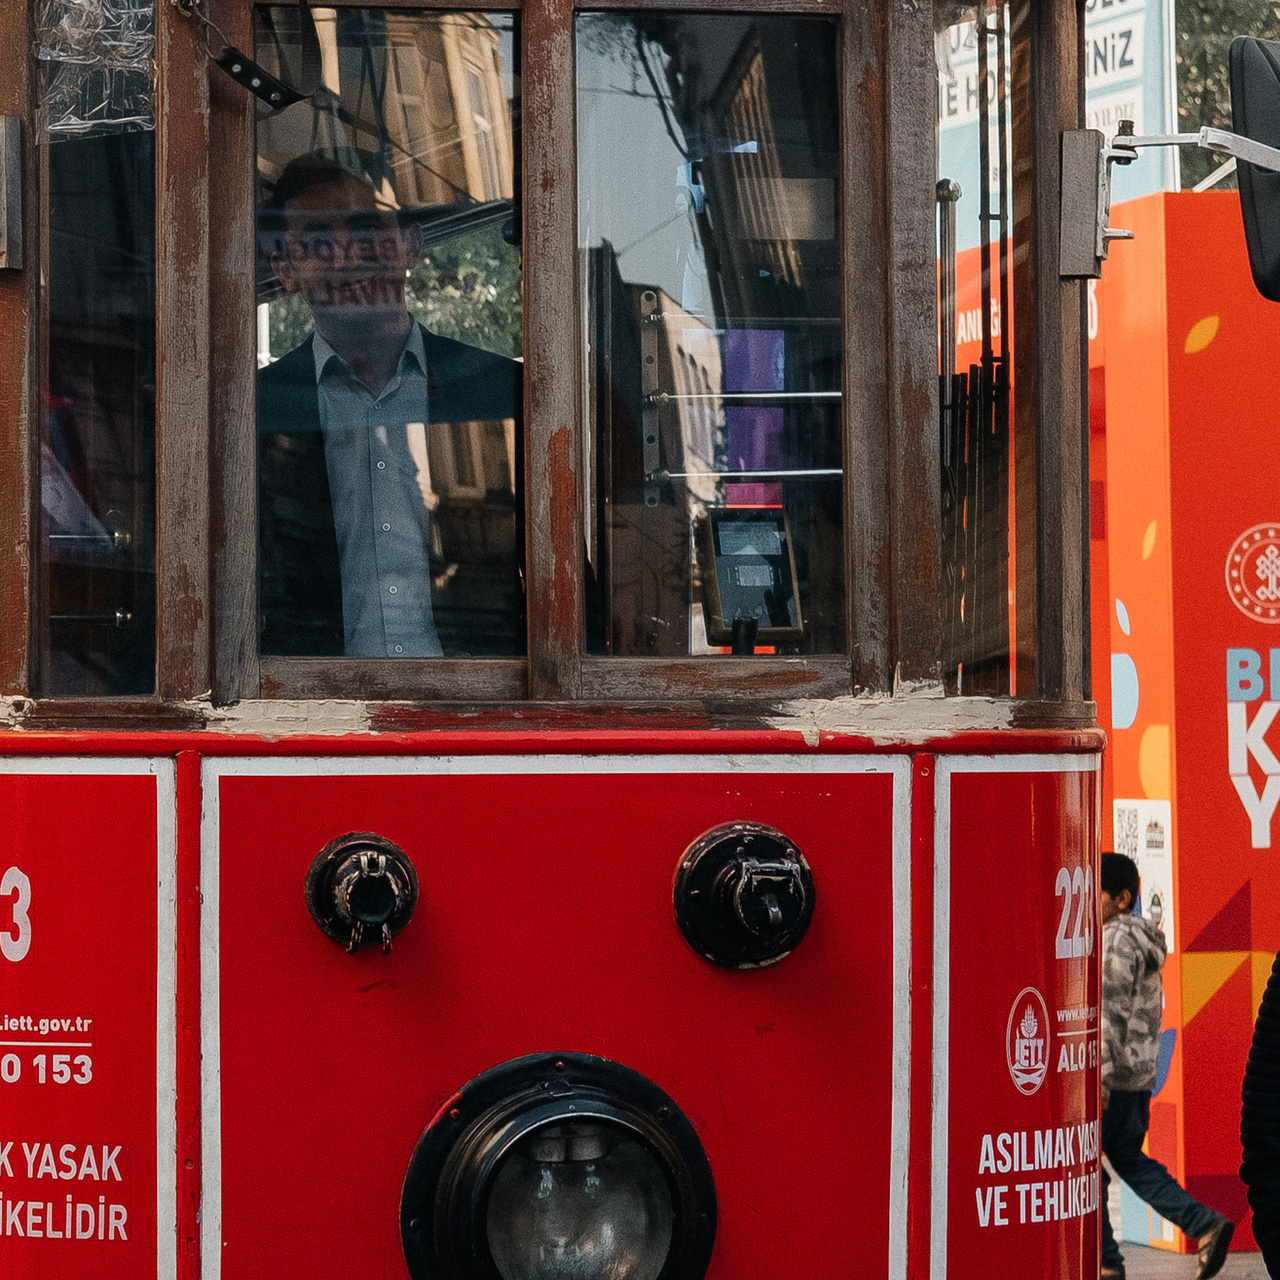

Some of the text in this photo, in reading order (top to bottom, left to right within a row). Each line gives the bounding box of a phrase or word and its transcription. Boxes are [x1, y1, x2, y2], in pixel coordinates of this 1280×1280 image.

[1054, 865, 1094, 959] 223
[32, 1054, 93, 1085] 153
[1057, 1042, 1086, 1073] ALO
[22, 1142, 122, 1181] YASAK
[978, 1128, 1075, 1174] ASILMAK
[975, 1185, 1009, 1227] VE
